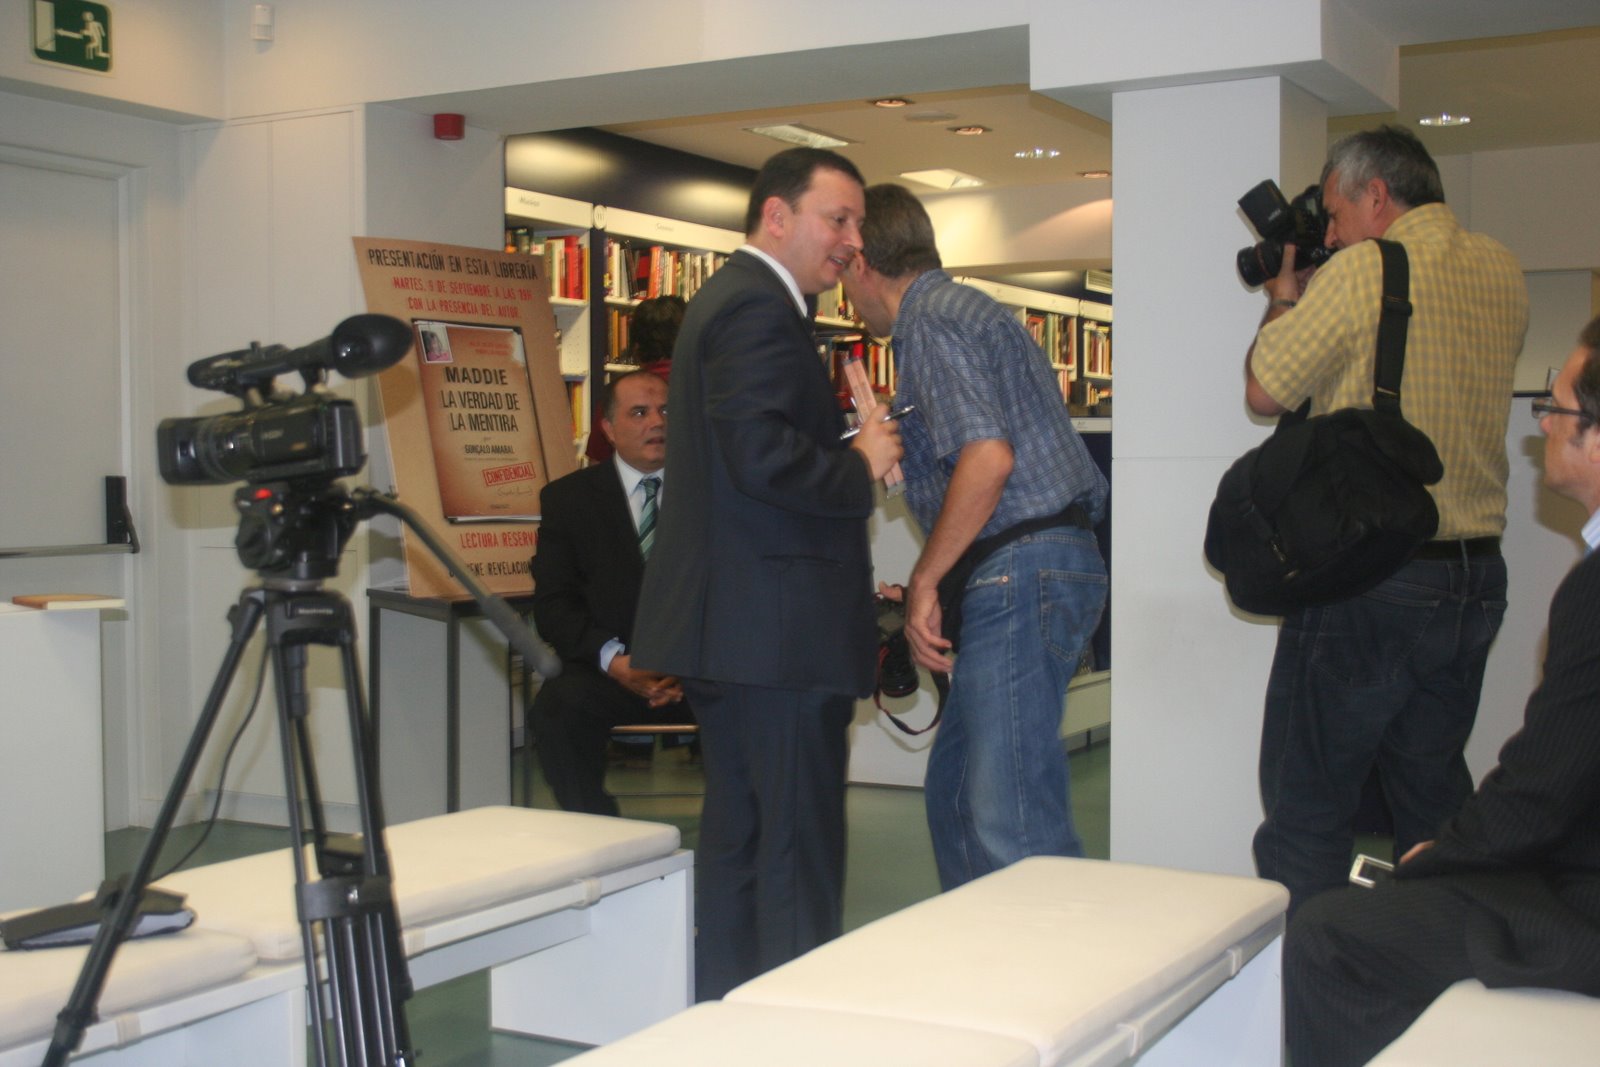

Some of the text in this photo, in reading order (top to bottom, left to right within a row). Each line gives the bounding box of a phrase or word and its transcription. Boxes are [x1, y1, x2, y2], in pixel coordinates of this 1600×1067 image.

[368, 248, 538, 280] PRESENTACIÓN EN ESTA LIBRERÍA
[408, 296, 423, 311] CON
[425, 298, 438, 312] LA
[439, 299, 479, 316] PRESENCIA
[480, 303, 496, 317] DEL
[444, 366, 509, 386] MADDIE
[440, 389, 520, 411] LA VERDAD DE
[449, 412, 519, 433] LA MENTIRA
[485, 464, 534, 484] CONFIDENCIAL
[460, 532, 500, 549] LECTURA
